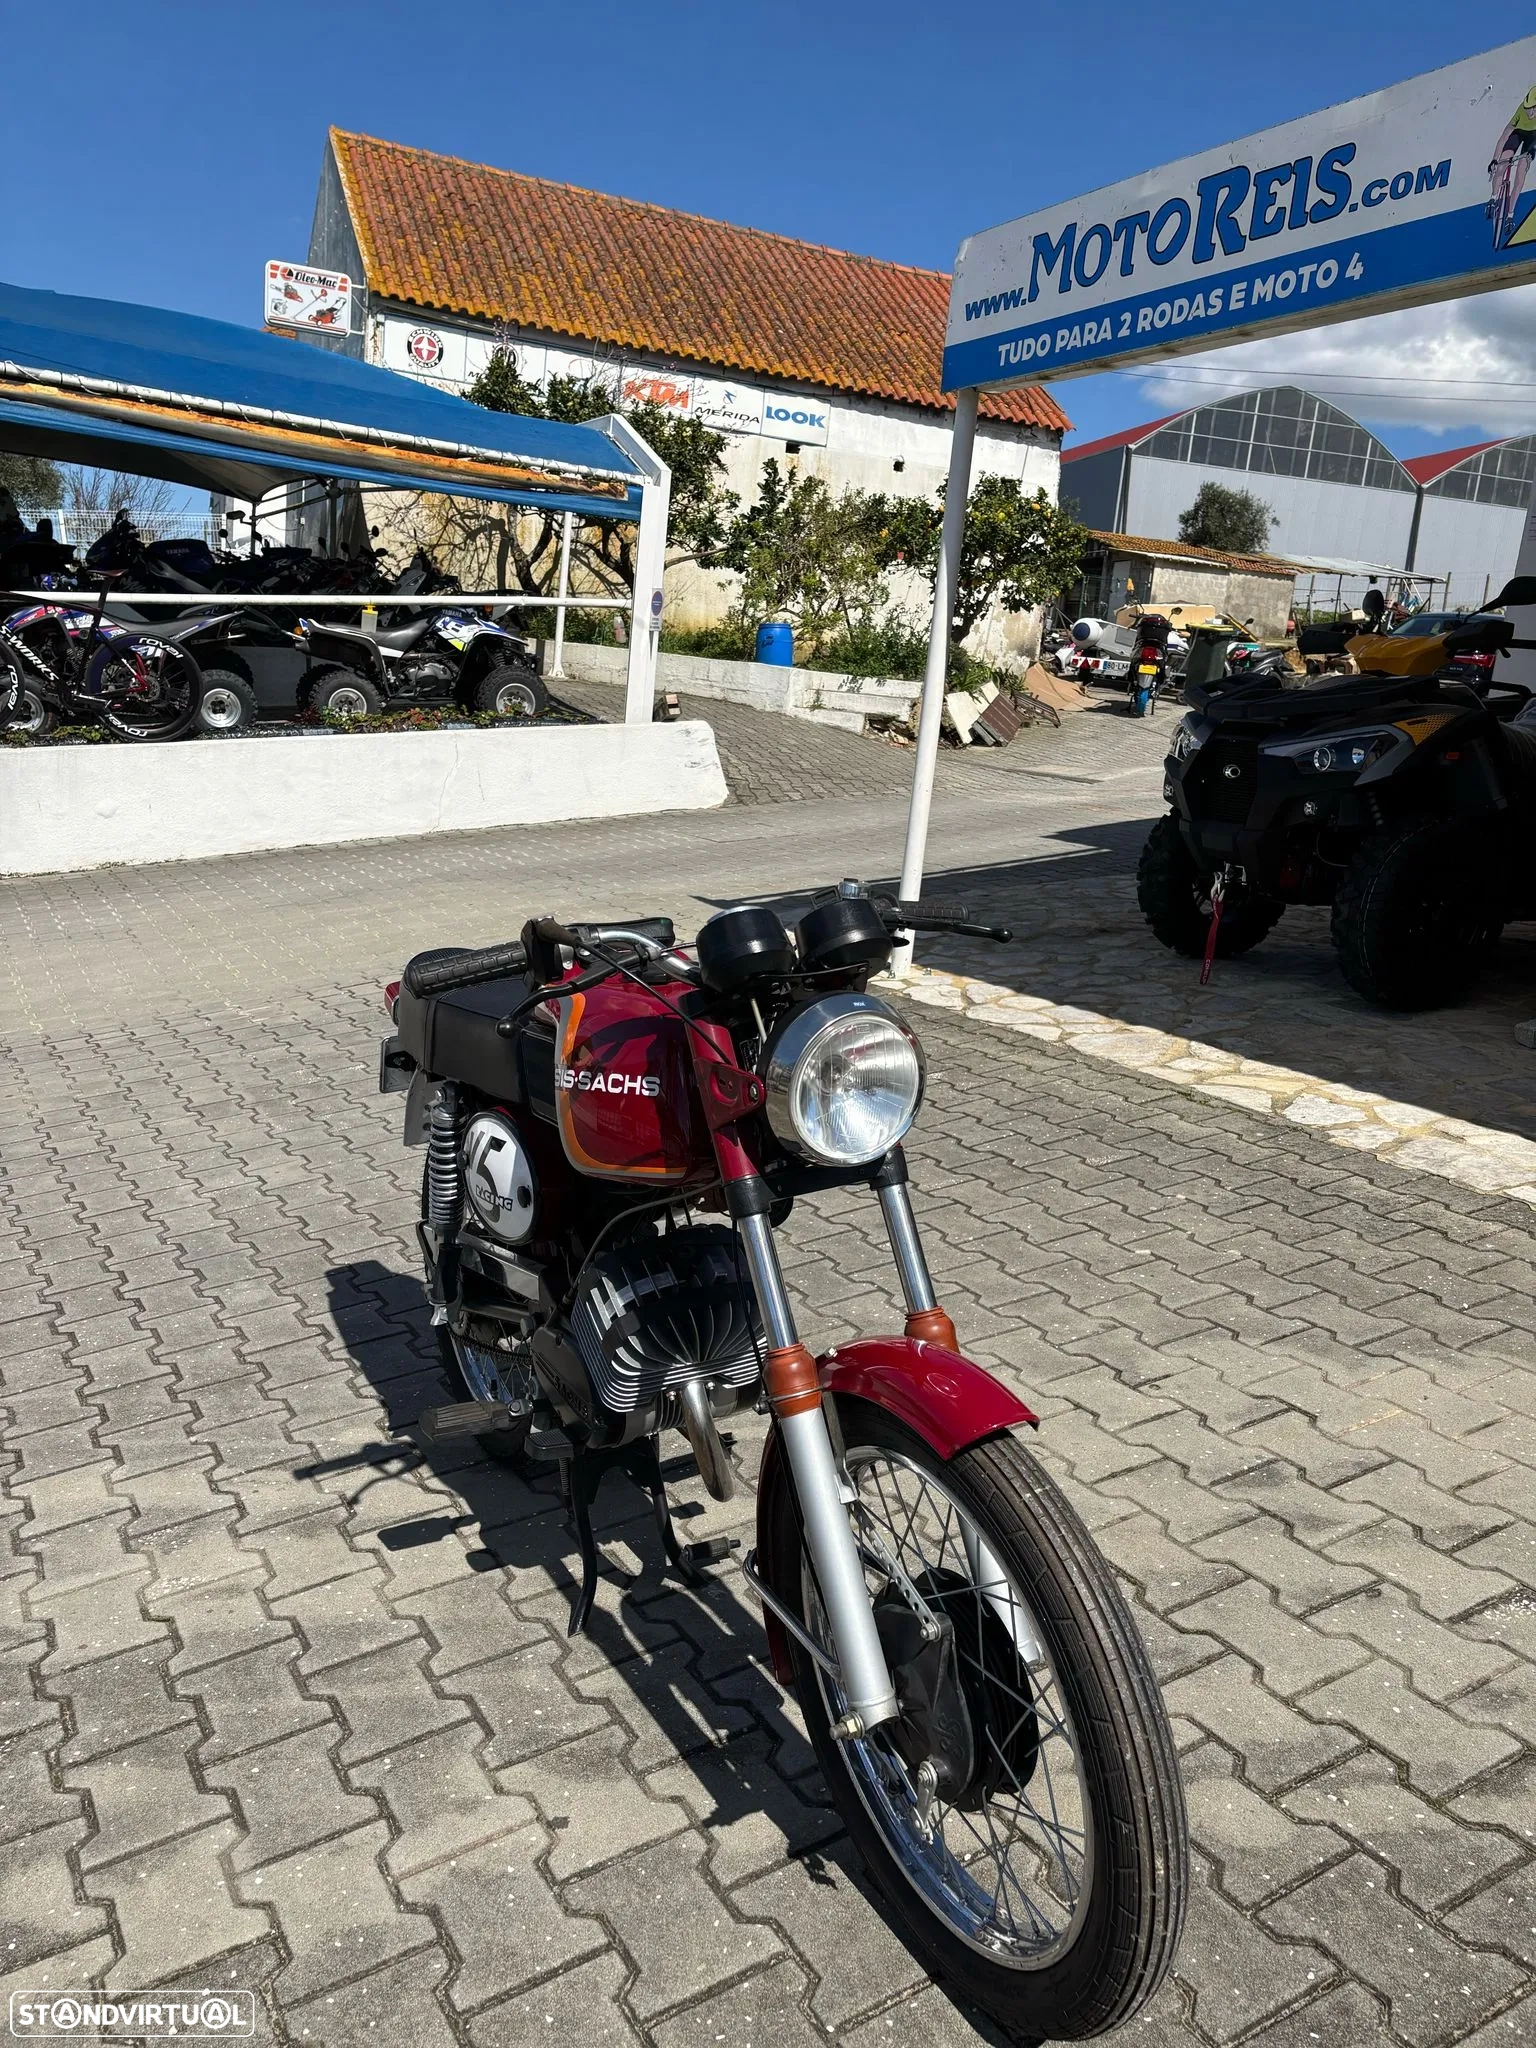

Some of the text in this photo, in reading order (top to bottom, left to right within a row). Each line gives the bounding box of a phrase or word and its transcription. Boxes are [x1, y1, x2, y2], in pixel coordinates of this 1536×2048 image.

[998, 252, 1364, 367] TUDO PARA 2 RODAS E MOTO 4
[622, 378, 690, 409] KTM
[694, 406, 761, 424] MERIDA
[765, 405, 826, 429] LOOK
[0, 624, 60, 681] S-WORKS
[138, 637, 184, 659] roval
[7, 664, 19, 711] roval
